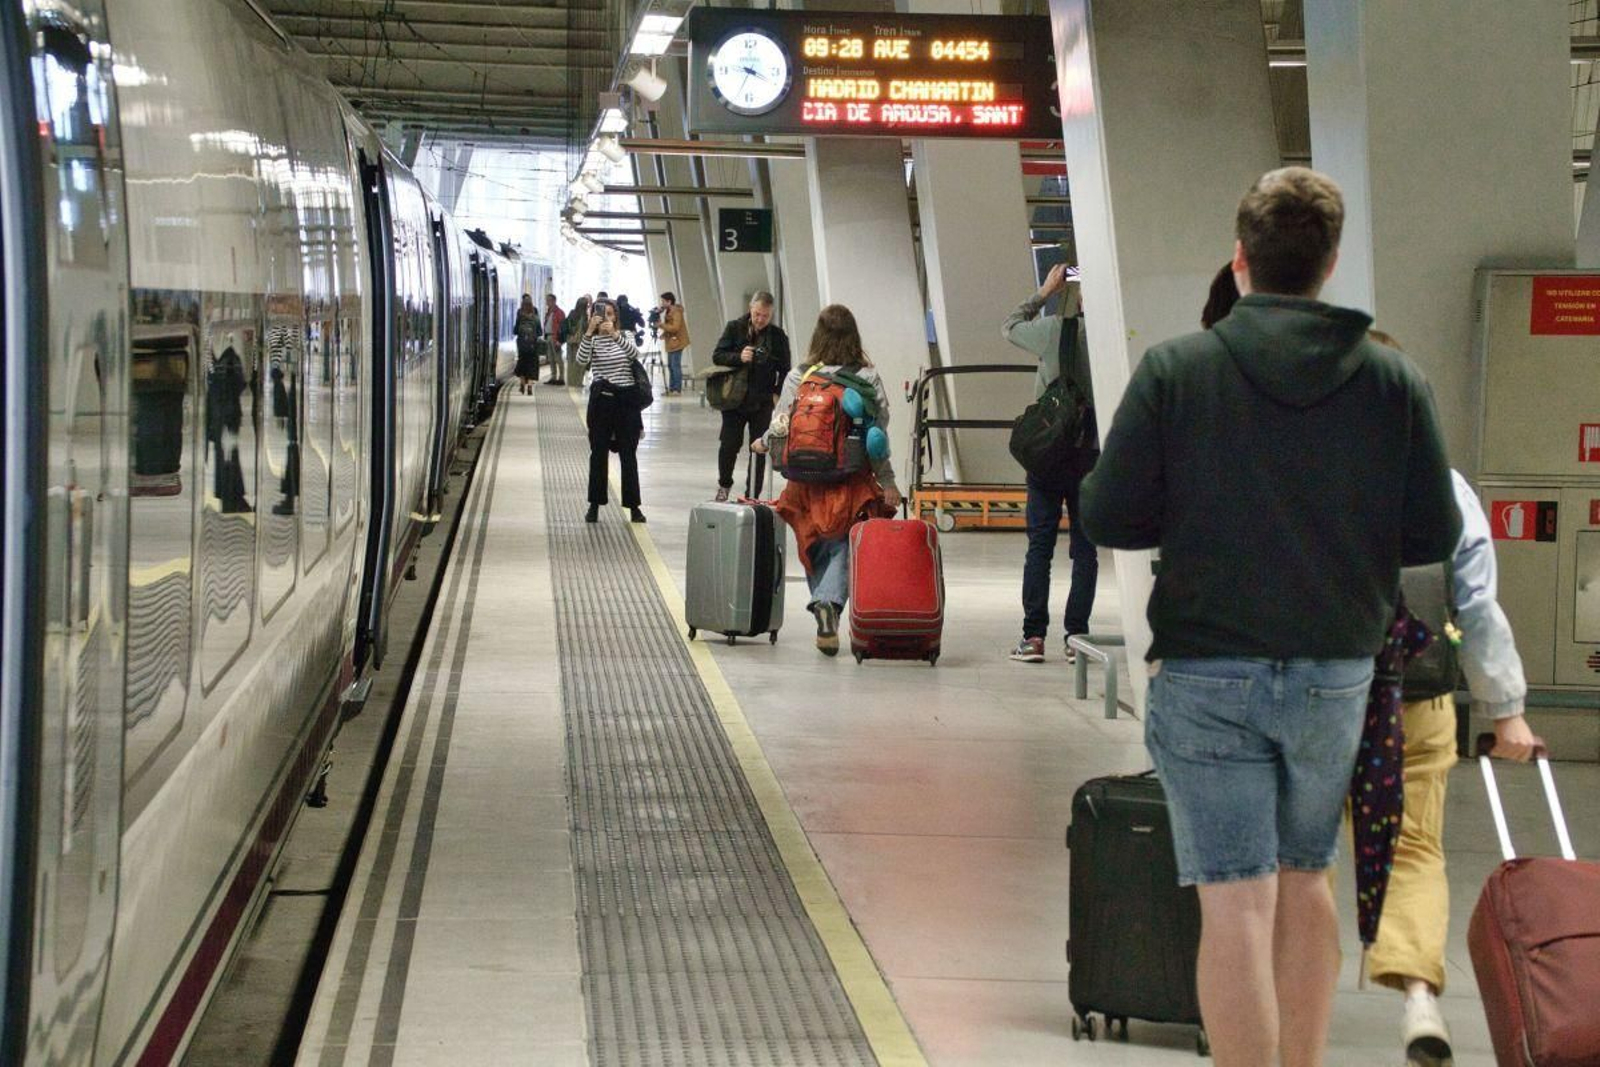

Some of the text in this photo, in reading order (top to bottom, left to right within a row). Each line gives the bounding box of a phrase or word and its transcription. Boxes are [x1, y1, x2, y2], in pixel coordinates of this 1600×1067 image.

[803, 25, 826, 34] Hora
[874, 25, 896, 36] Tren
[804, 38, 990, 61] 09:28 AVE 04454
[802, 66, 834, 76] Destino
[809, 78, 995, 102] MADRID CHAMARTIN
[803, 102, 1023, 125] CIA DE AROUSA, SANT
[724, 228, 738, 251] 3
